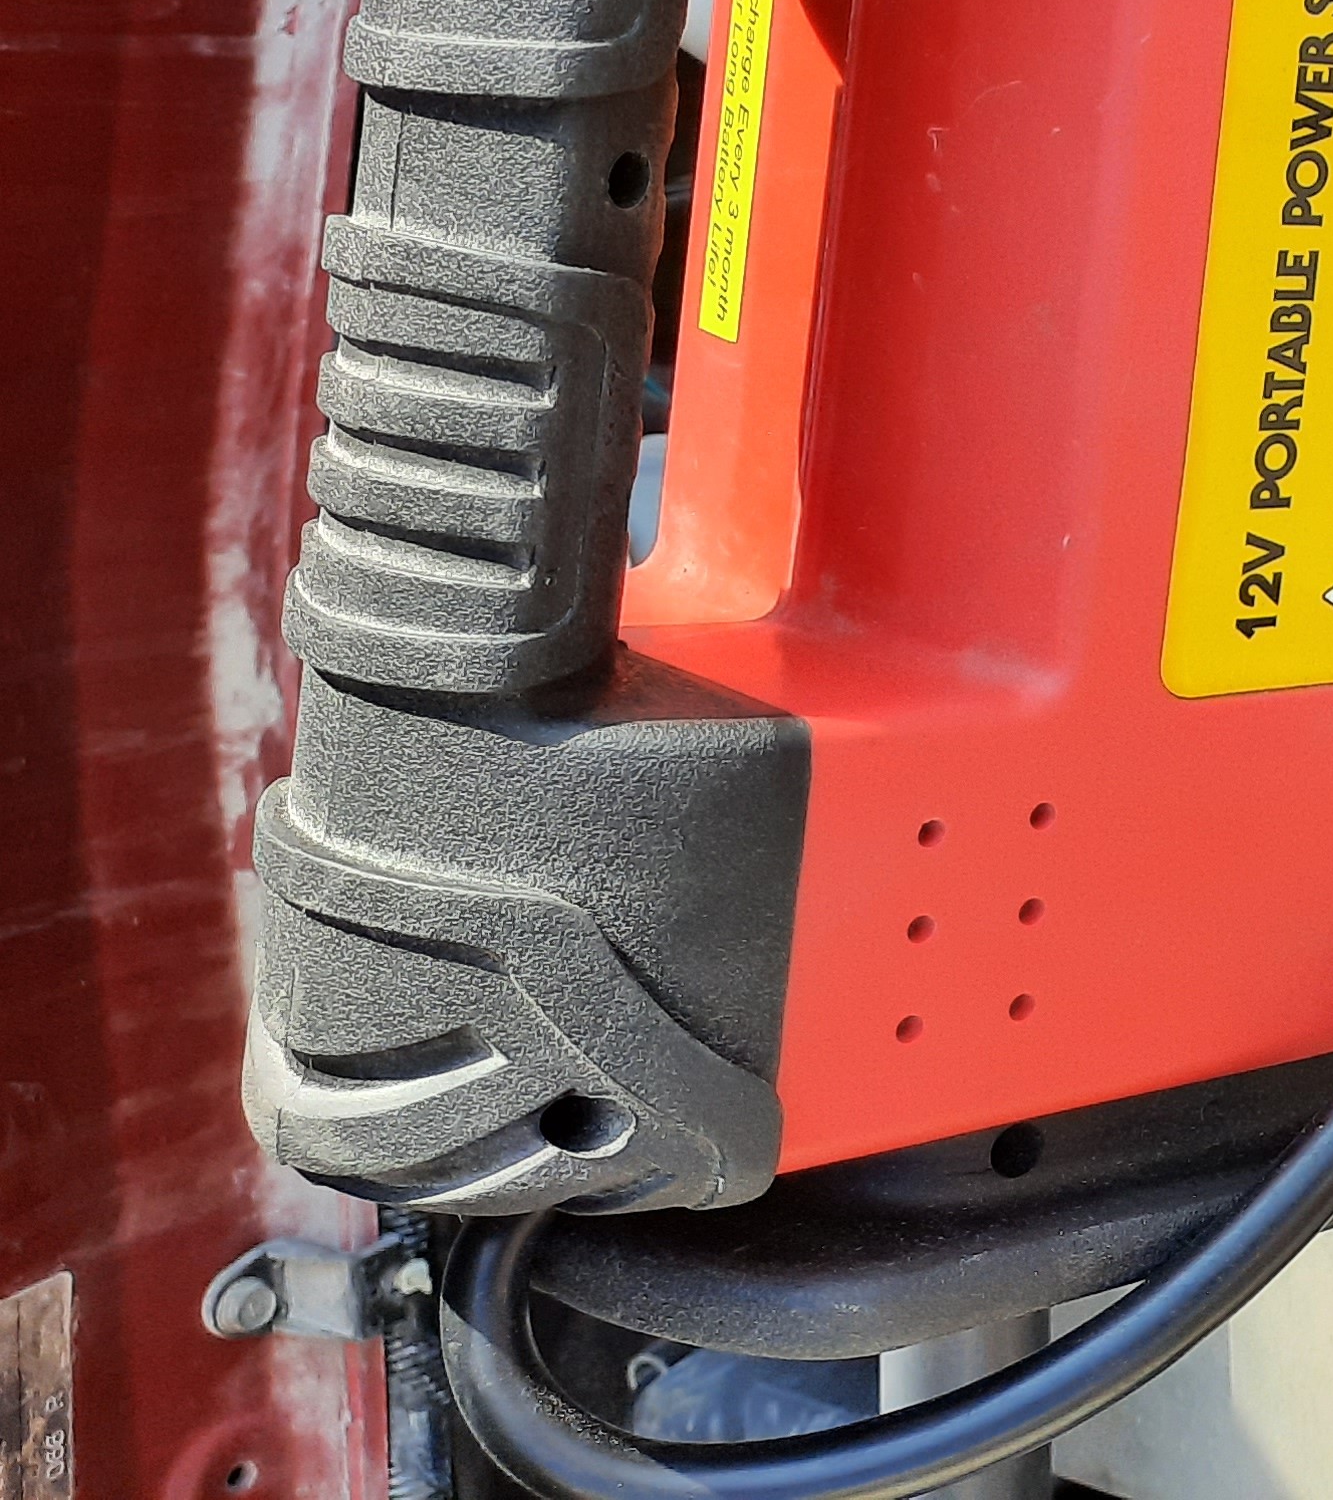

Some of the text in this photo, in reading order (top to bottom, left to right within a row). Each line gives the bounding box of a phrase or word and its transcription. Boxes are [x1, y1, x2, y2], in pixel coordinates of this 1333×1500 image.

[725, 25, 743, 94] Long
[714, 109, 736, 213] Battery
[732, 106, 750, 183] Every
[727, 199, 740, 220] 3
[706, 222, 722, 289] Life!
[716, 225, 735, 323] month
[1248, 249, 1320, 510] PORTABLE
[1234, 531, 1286, 639] 12V
